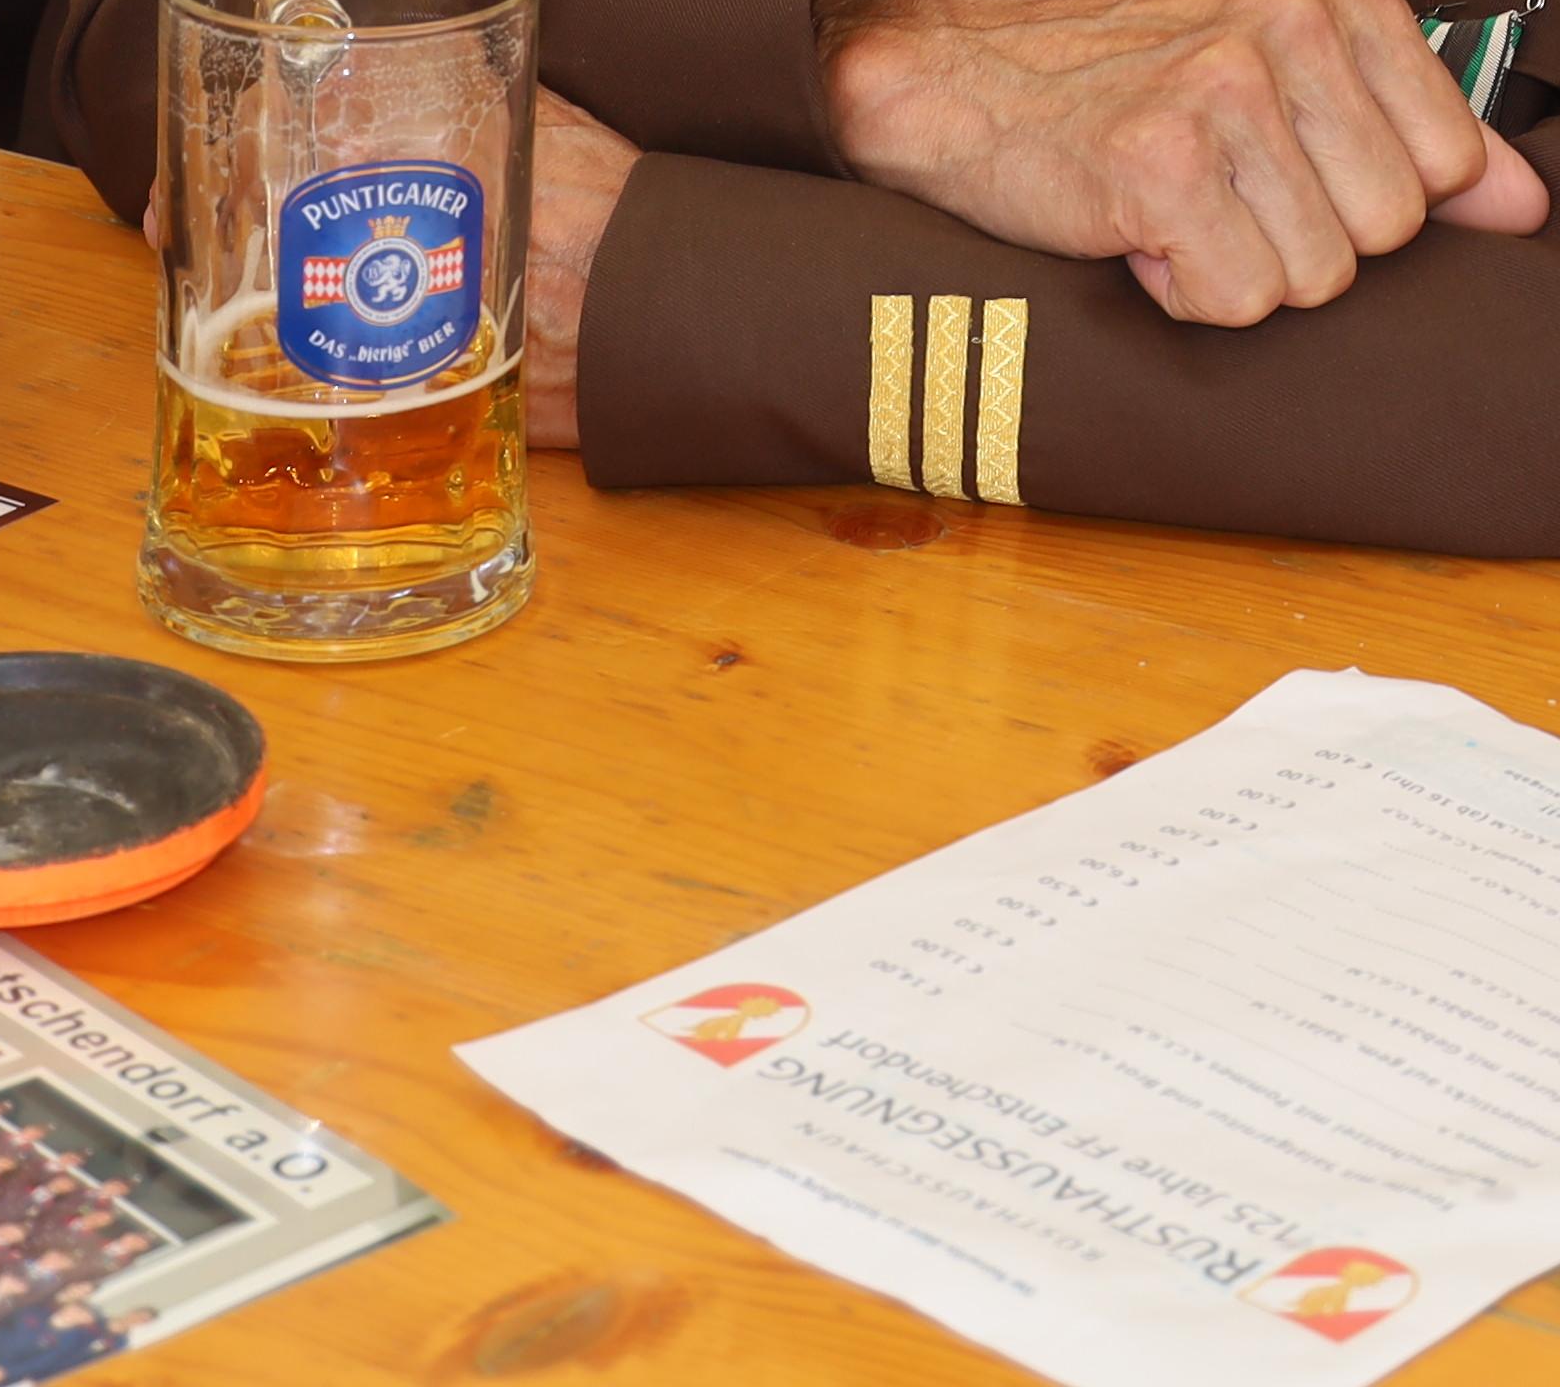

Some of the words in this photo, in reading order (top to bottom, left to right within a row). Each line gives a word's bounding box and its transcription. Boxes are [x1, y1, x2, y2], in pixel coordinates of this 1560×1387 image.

[302, 182, 468, 230] PUNTIGAMER
[308, 330, 347, 360] DAS
[418, 321, 455, 354] BIER
[1381, 769, 1426, 795] Uhr)
[1455, 804, 1491, 823] (ab
[1426, 994, 1500, 1031] Gebäck
[1389, 1016, 1462, 1056] Gebäck
[1464, 1051, 1501, 1073] mit
[822, 1031, 1068, 1137] Entschendorf
[1159, 1086, 1204, 1110] und
[1208, 1061, 1292, 1109] Pommes
[1063, 1135, 1119, 1160] FF
[763, 1058, 1259, 1285] RÜSTHAUSSEGNUNG
[795, 1121, 1103, 1262] RÜSTHAUSSCHAUN
[1121, 1158, 1227, 1208] Jahre
[1226, 1203, 1299, 1244] 125
